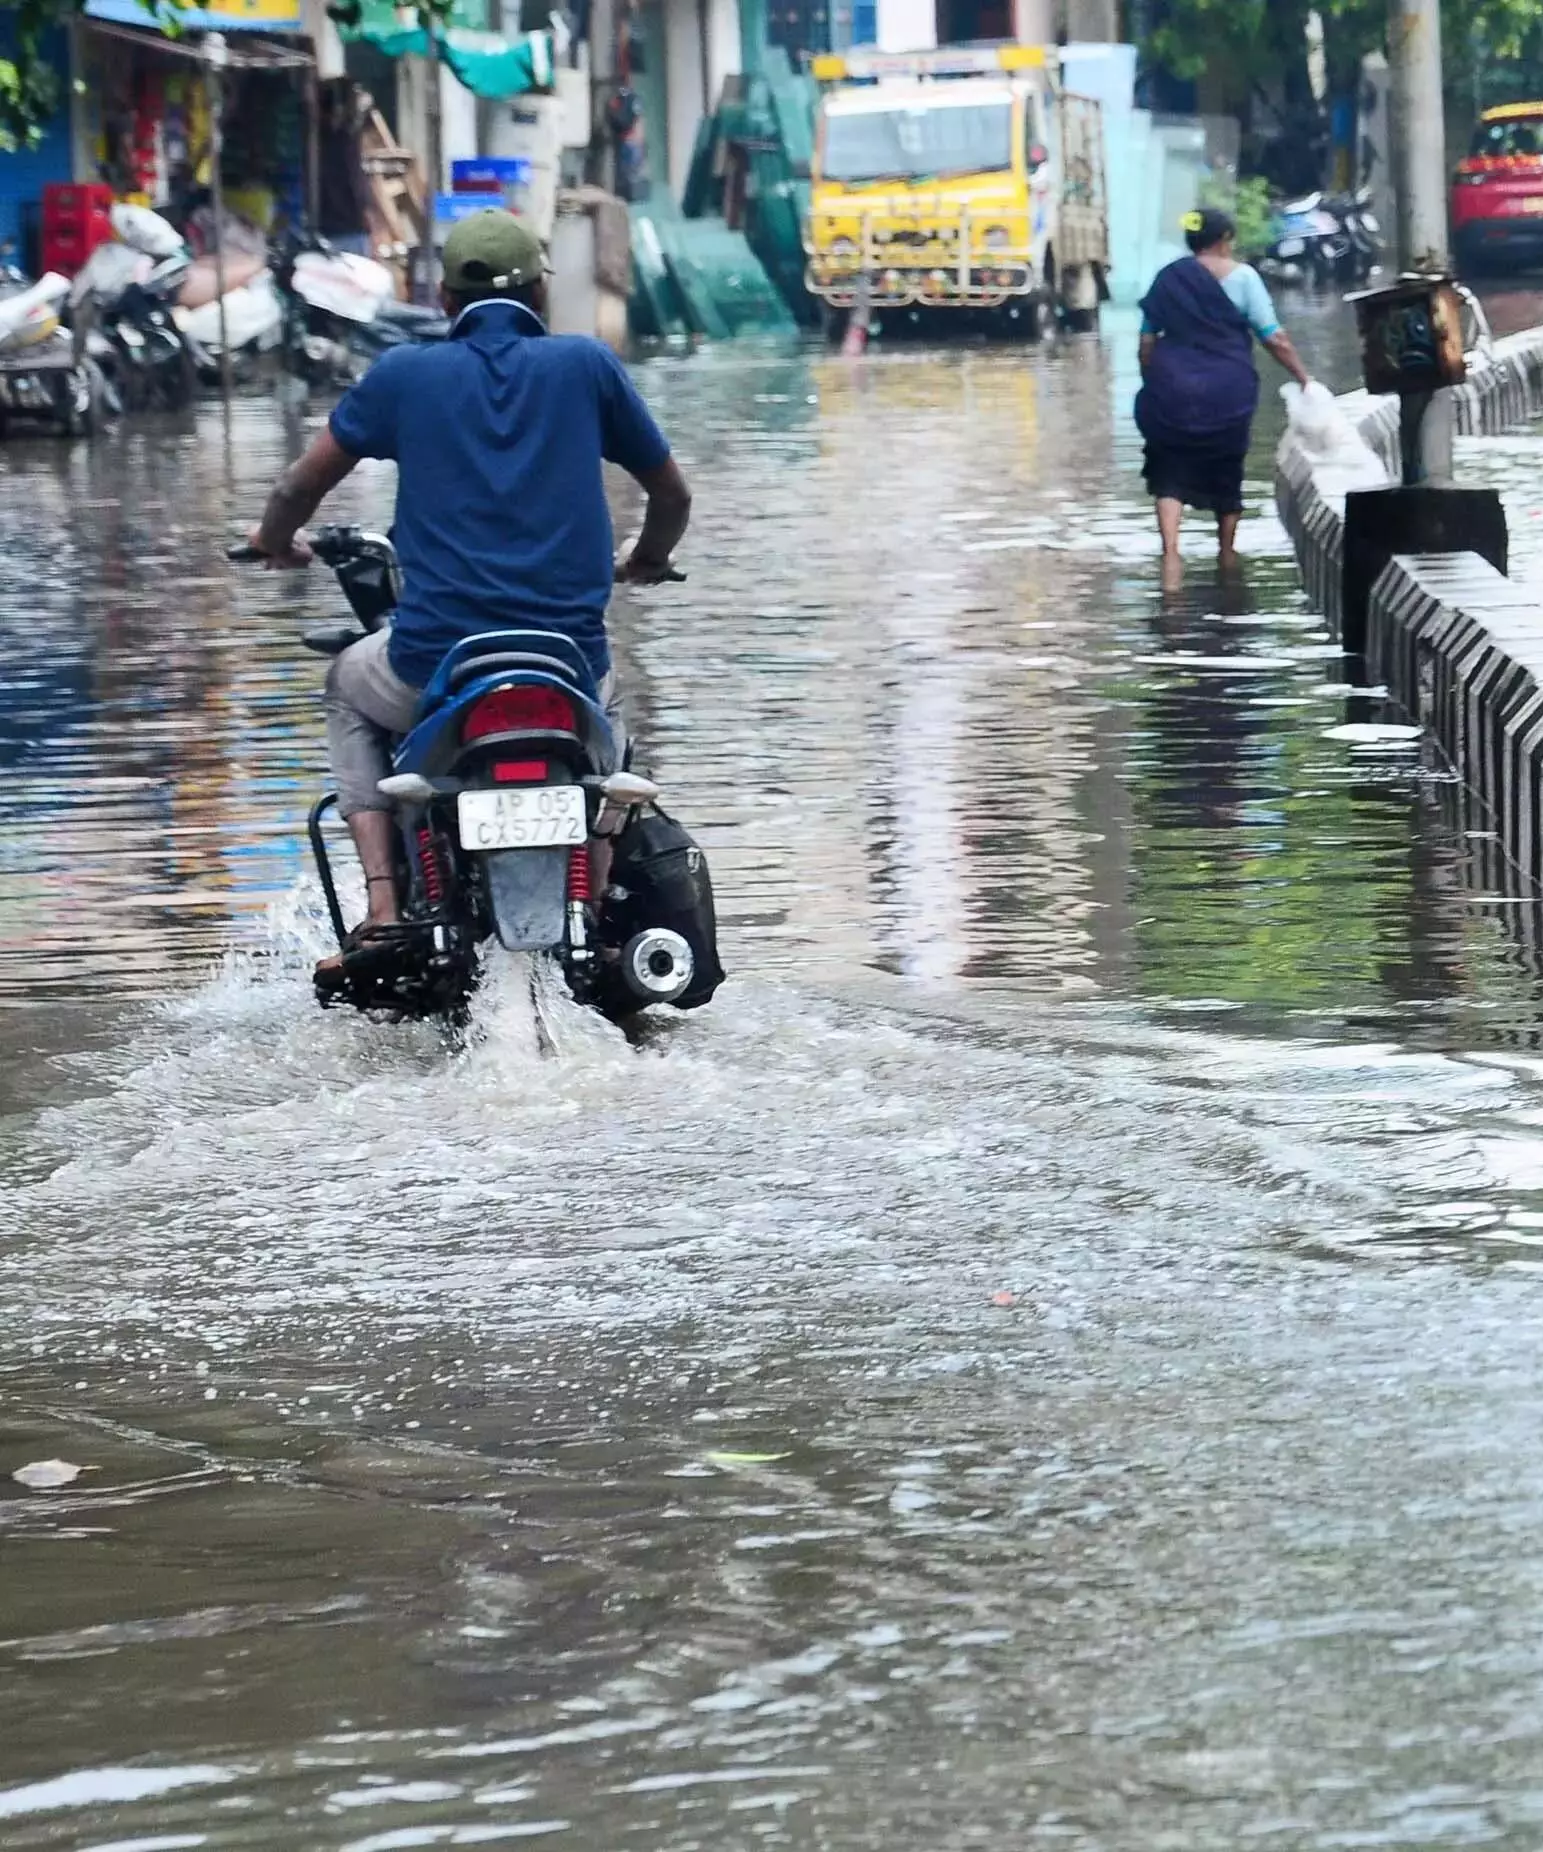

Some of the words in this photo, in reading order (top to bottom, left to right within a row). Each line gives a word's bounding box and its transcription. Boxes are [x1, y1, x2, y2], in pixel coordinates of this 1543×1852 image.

[495, 793, 527, 817] AP
[538, 791, 570, 815] 05
[478, 817, 580, 844] CX5772
